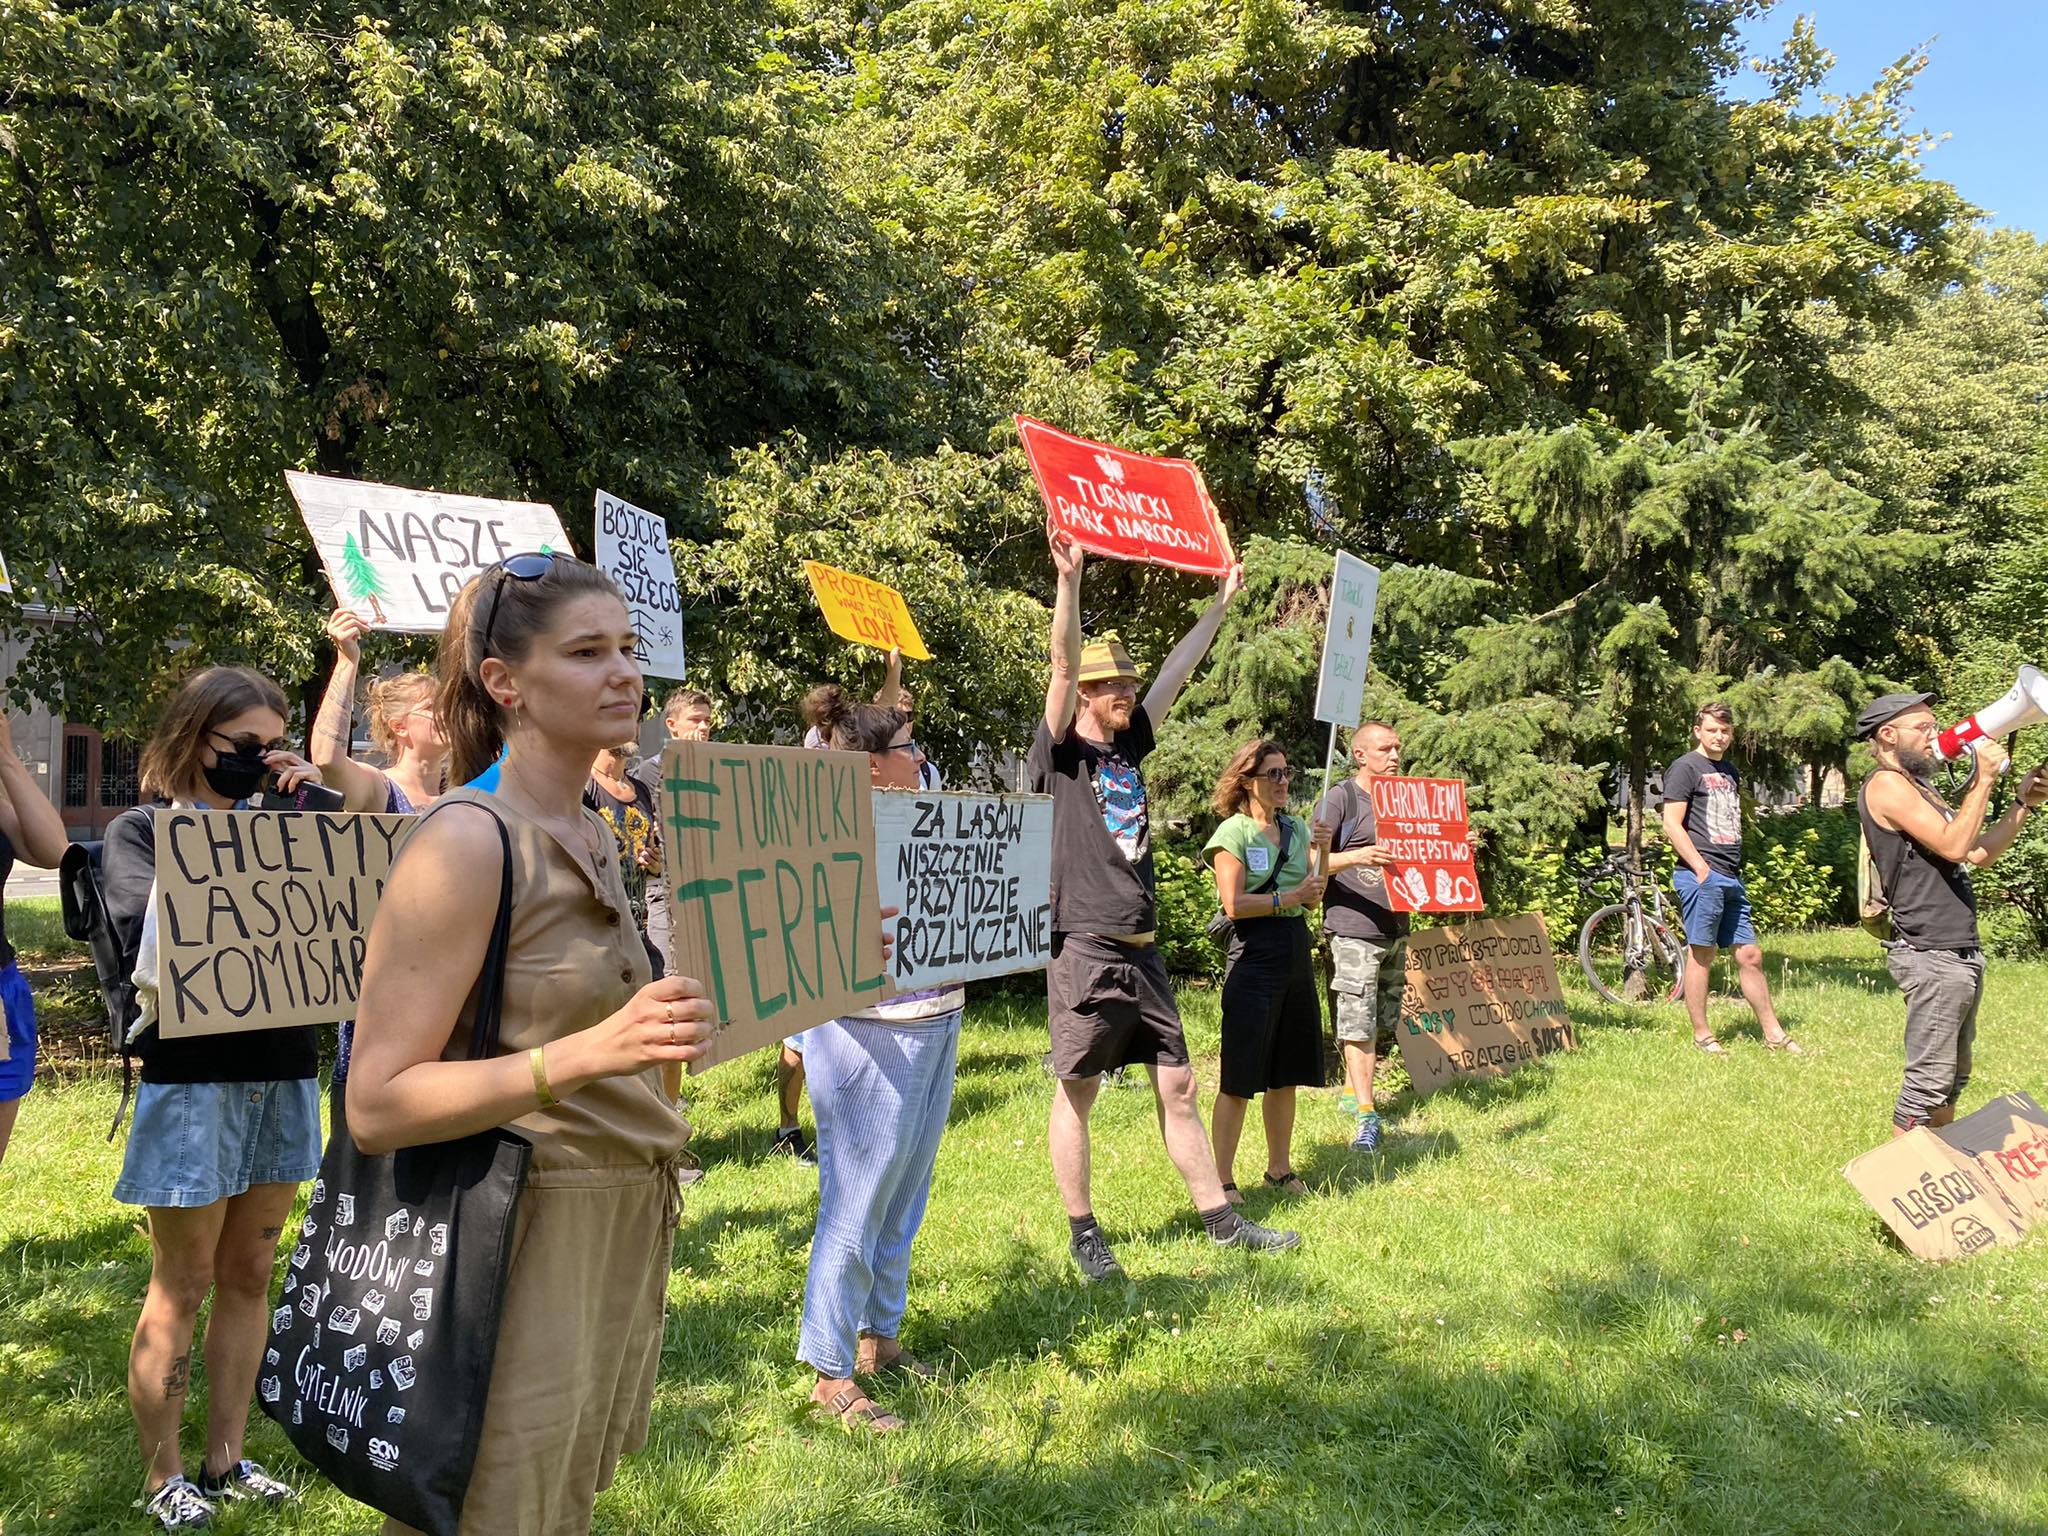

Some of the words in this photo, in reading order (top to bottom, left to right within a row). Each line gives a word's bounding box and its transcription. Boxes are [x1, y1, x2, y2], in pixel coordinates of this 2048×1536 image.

[1067, 474, 1174, 521] TURNICKI
[359, 509, 512, 568] NASZE
[603, 501, 666, 554] BÓJCIE
[1056, 495, 1112, 537] PARK
[1113, 515, 1210, 553] NARODOWY
[618, 541, 648, 577] SIĘ
[412, 572, 462, 612] LA
[811, 565, 899, 610] PROTECT
[851, 613, 904, 651] LOVE
[868, 604, 894, 622] YOU
[664, 754, 858, 868] #TURNICKI
[911, 800, 945, 838] ZA
[956, 794, 1024, 844] LASÓW
[1373, 781, 1430, 820] OCHRONA
[169, 813, 404, 884] CHCEMY
[1395, 822, 1414, 835] TO
[1417, 823, 1441, 836] NIE
[898, 842, 1008, 882] NISZCZENIE
[906, 876, 1020, 930] PRZYJDZIE
[677, 852, 886, 1023] TERAZ
[896, 903, 1050, 978] ROZLICZENIE
[1434, 934, 1542, 966] PAŃSTWOWE
[169, 936, 367, 1023] KOMISAR
[1403, 1007, 1455, 1035] LASY
[369, 1437, 399, 1460] SQN
